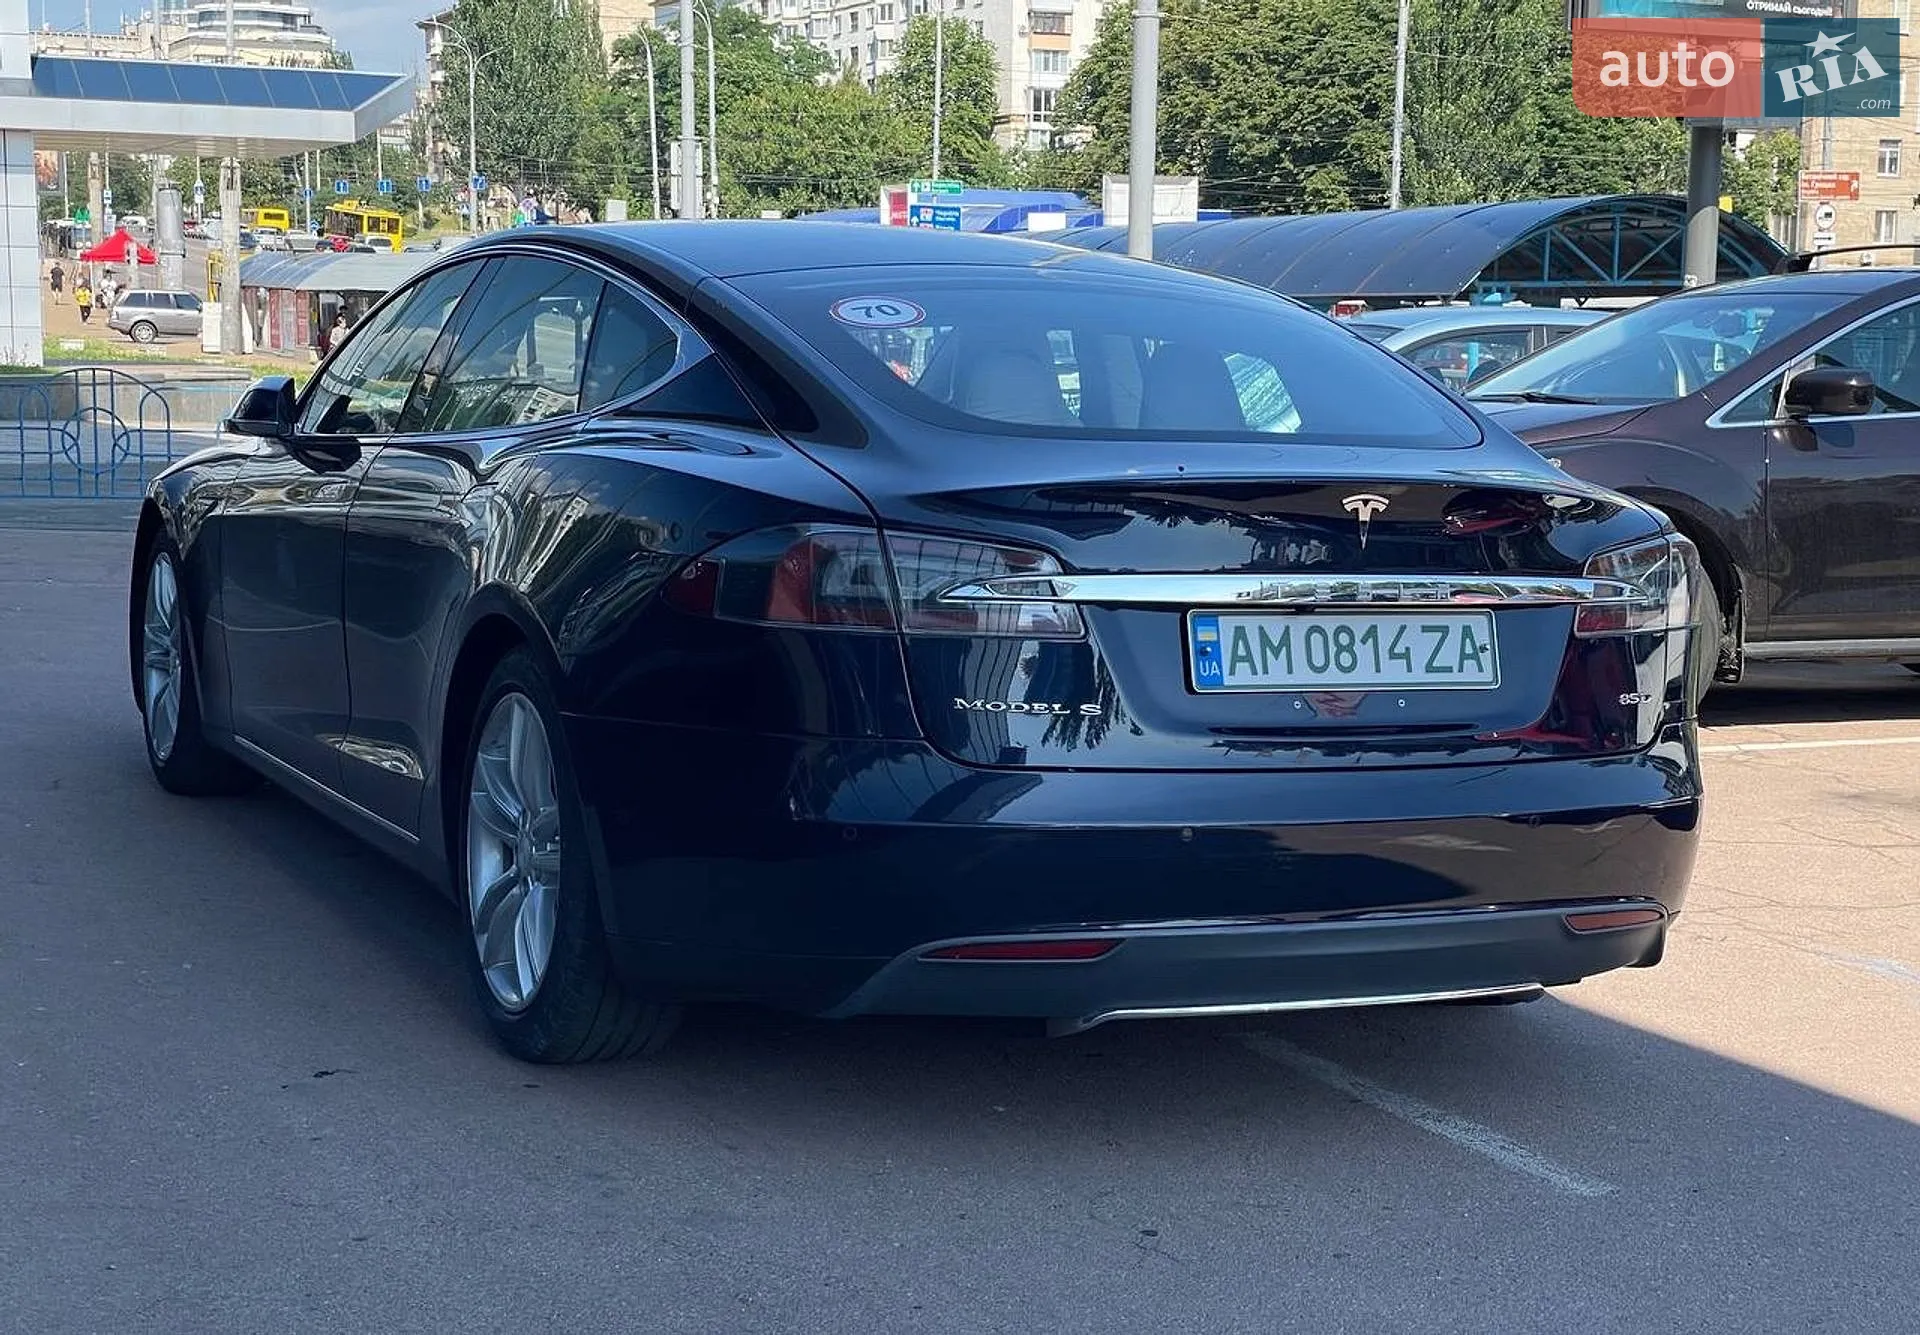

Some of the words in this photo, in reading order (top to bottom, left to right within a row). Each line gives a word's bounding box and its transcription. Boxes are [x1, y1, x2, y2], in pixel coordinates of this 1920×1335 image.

[850, 304, 901, 319] 70
[1199, 660, 1221, 677] UA
[953, 697, 1071, 714] MODEL
[1079, 703, 1102, 716] S
